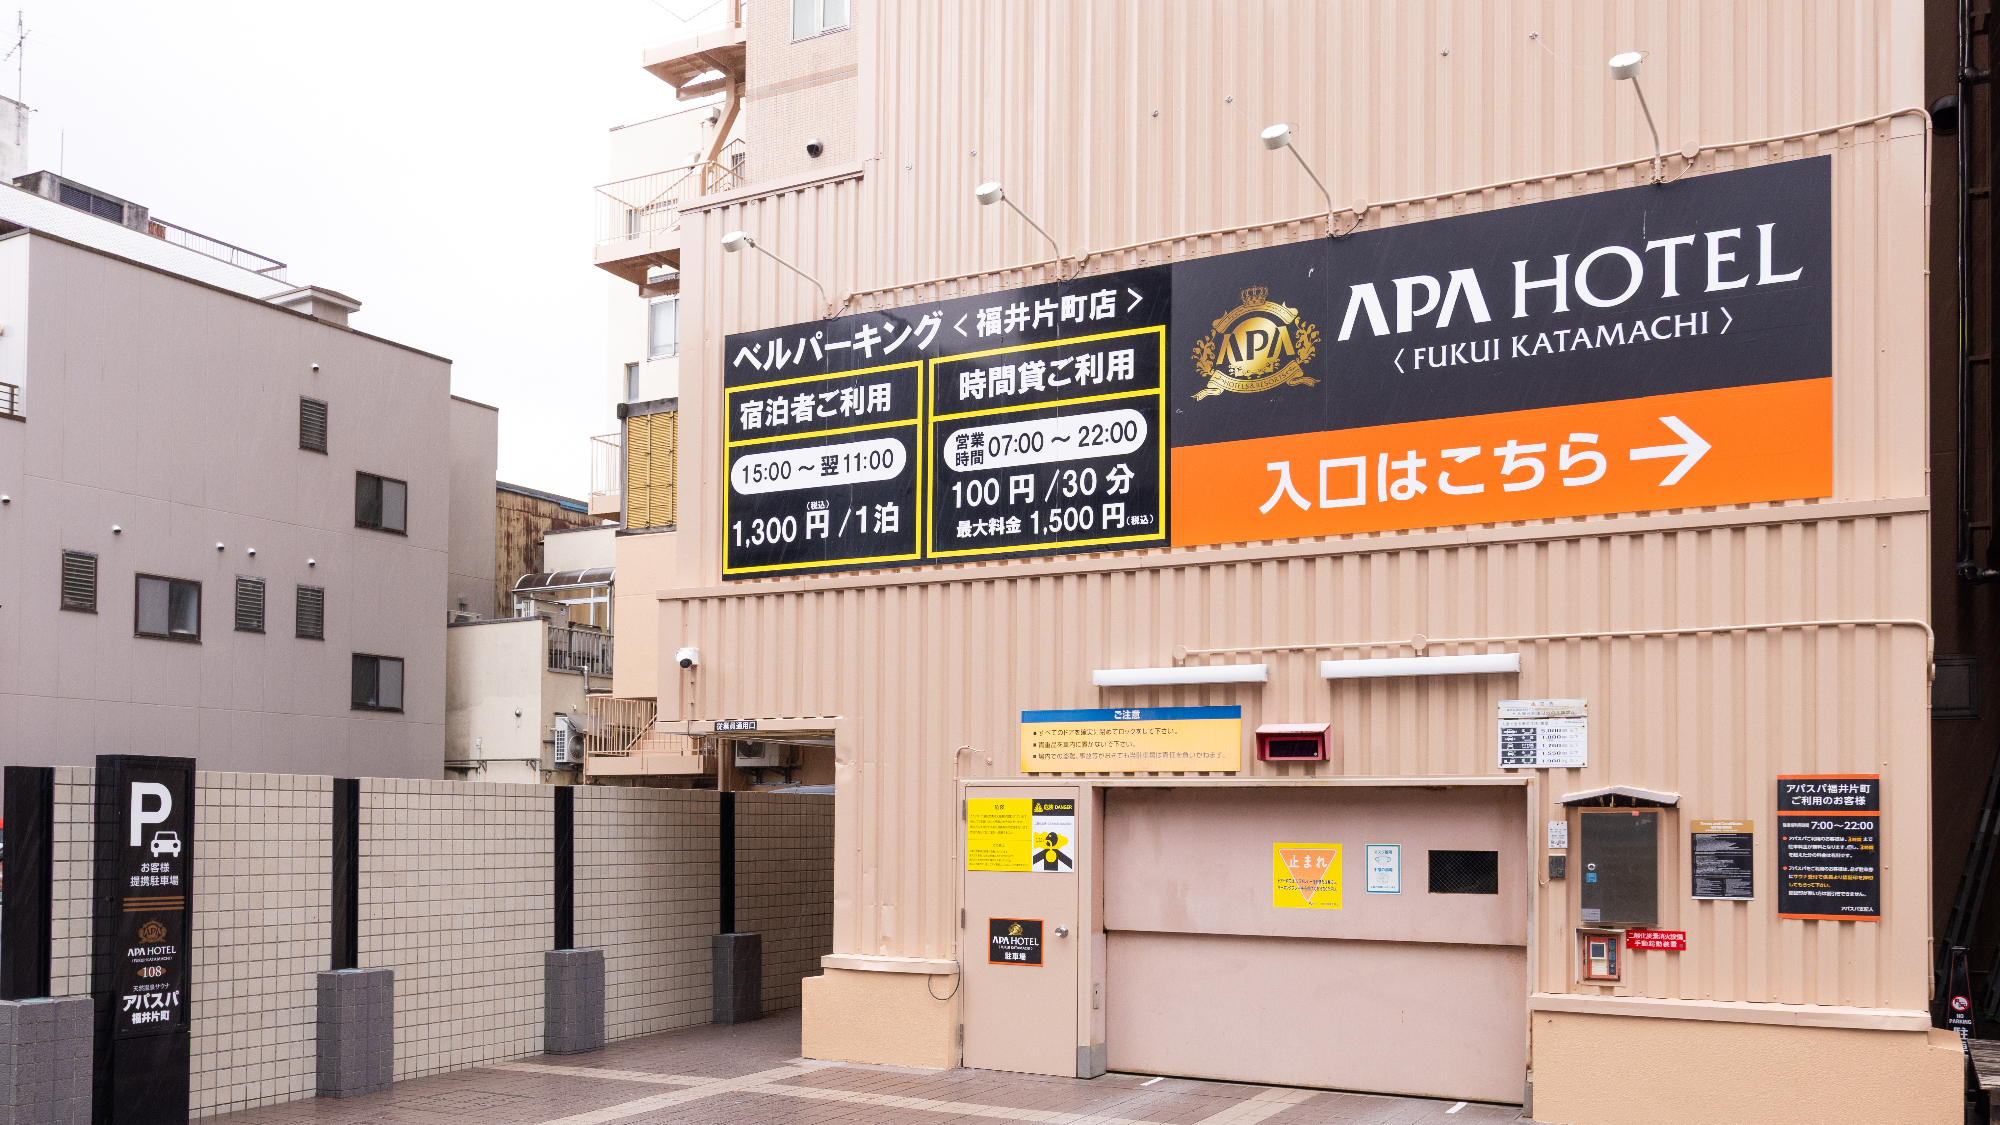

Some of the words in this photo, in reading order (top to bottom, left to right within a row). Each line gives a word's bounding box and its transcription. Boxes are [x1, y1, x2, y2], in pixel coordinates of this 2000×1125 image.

[1337, 268, 1492, 341] APA
[1511, 223, 1803, 319] HOTEL
[733, 310, 944, 371] ベルパーキング
[1215, 326, 1296, 365] APA
[959, 348, 1135, 401] 時間貸ご利用
[740, 383, 892, 430] 宿泊者ご利用
[955, 432, 985, 449] 営業
[988, 431, 1044, 457] 07:00
[1078, 420, 1138, 447] 22:00
[955, 450, 985, 467] 時間
[742, 460, 792, 484] 15:00
[1258, 433, 1607, 515] 入口はこちら
[952, 478, 1000, 508] 100
[1105, 463, 1135, 496] 分
[956, 515, 1022, 538] 最大料金
[1030, 505, 1094, 535] 1,500
[733, 515, 797, 548] 1,300
[1113, 709, 1141, 720] ご注意
[716, 721, 756, 731] 従業員通用口
[1786, 783, 1871, 794] アパスパ福井片町
[1791, 795, 1866, 806] ご利用のお客様
[130, 781, 172, 847] P
[141, 861, 170, 873] お客様
[1288, 854, 1328, 869] 止まれ
[130, 874, 179, 887] 提携駐車場
[992, 935, 1010, 945] APA
[1010, 936, 1040, 946] HOTEL
[127, 948, 146, 957] APA
[147, 945, 177, 955] HOTEL
[142, 965, 162, 978] 108
[123, 990, 180, 1012] アパスパ
[132, 1010, 170, 1025] 福井片町
